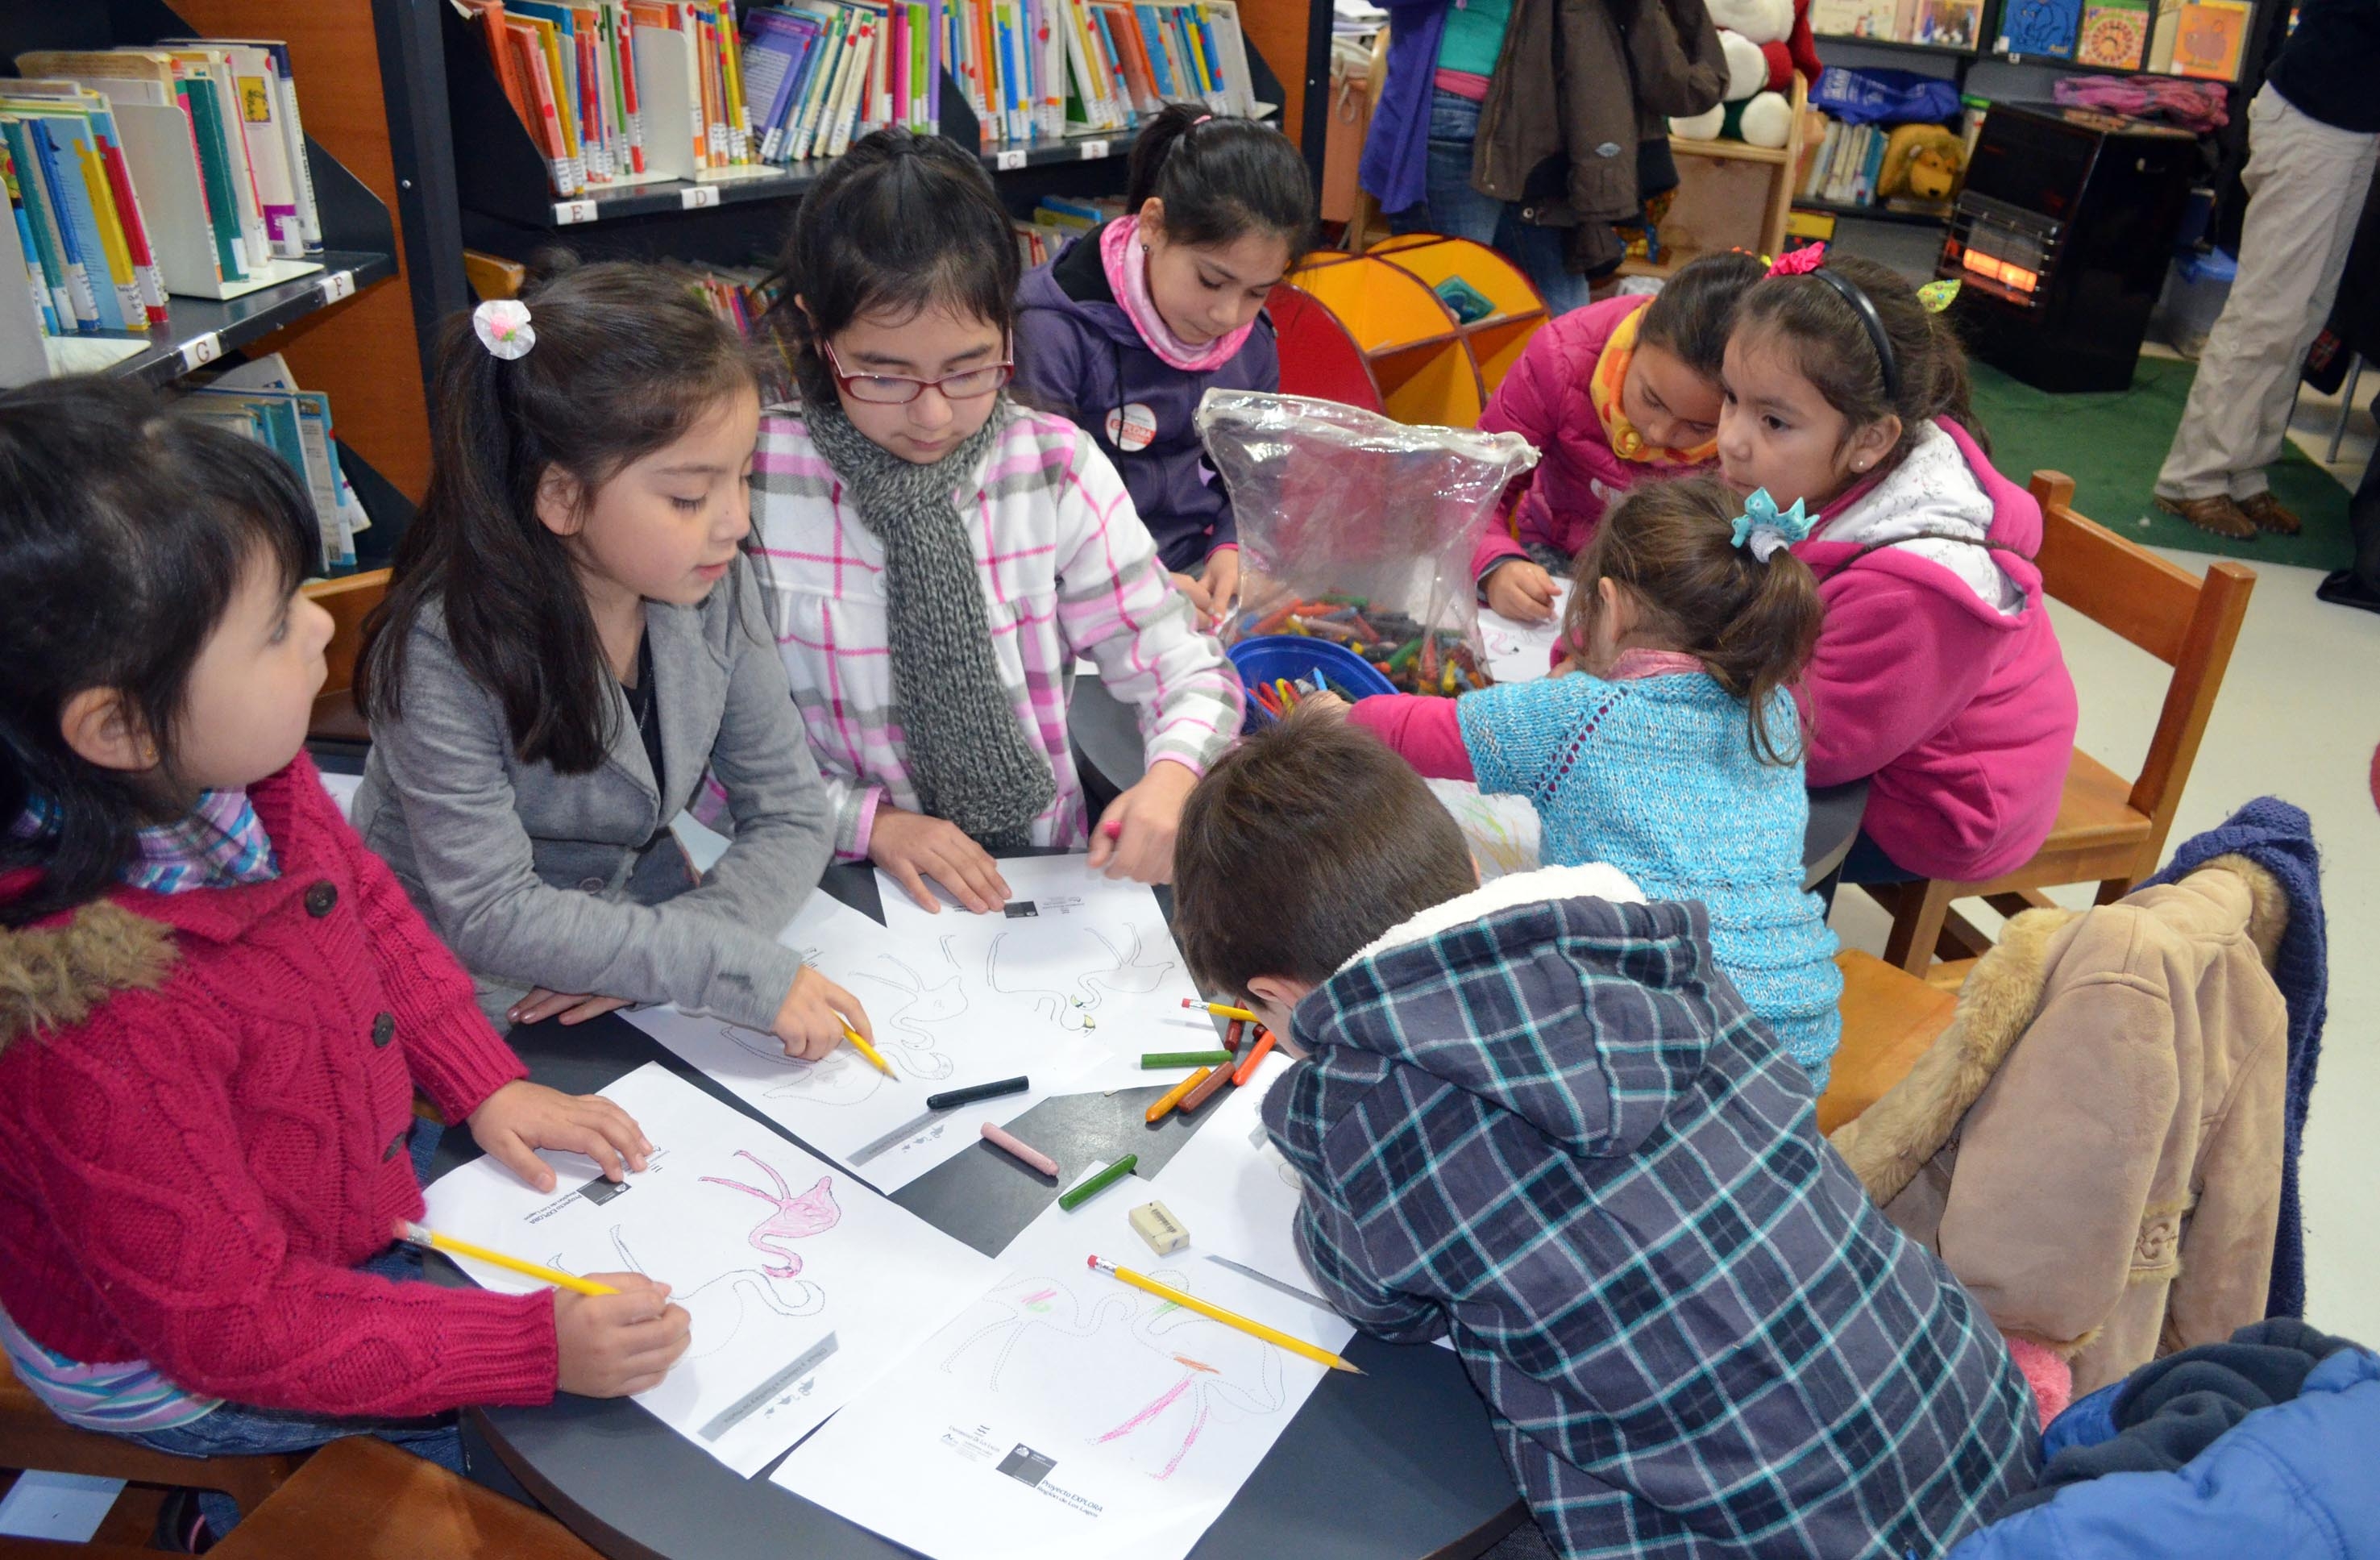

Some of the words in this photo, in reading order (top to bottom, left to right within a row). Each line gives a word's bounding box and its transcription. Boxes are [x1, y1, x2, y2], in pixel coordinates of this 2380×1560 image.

[1007, 154, 1018, 168] C
[694, 189, 707, 207] D
[570, 205, 584, 223] E
[333, 276, 343, 297] F
[196, 340, 210, 363] G
[530, 1208, 558, 1224] EXPLORA
[1036, 1485, 1059, 1500] Región
[1067, 1500, 1079, 1509] Los
[1080, 1506, 1099, 1518] Lagos
[1042, 1479, 1071, 1498] Proyecto
[1071, 1494, 1103, 1512] EXPLORA
